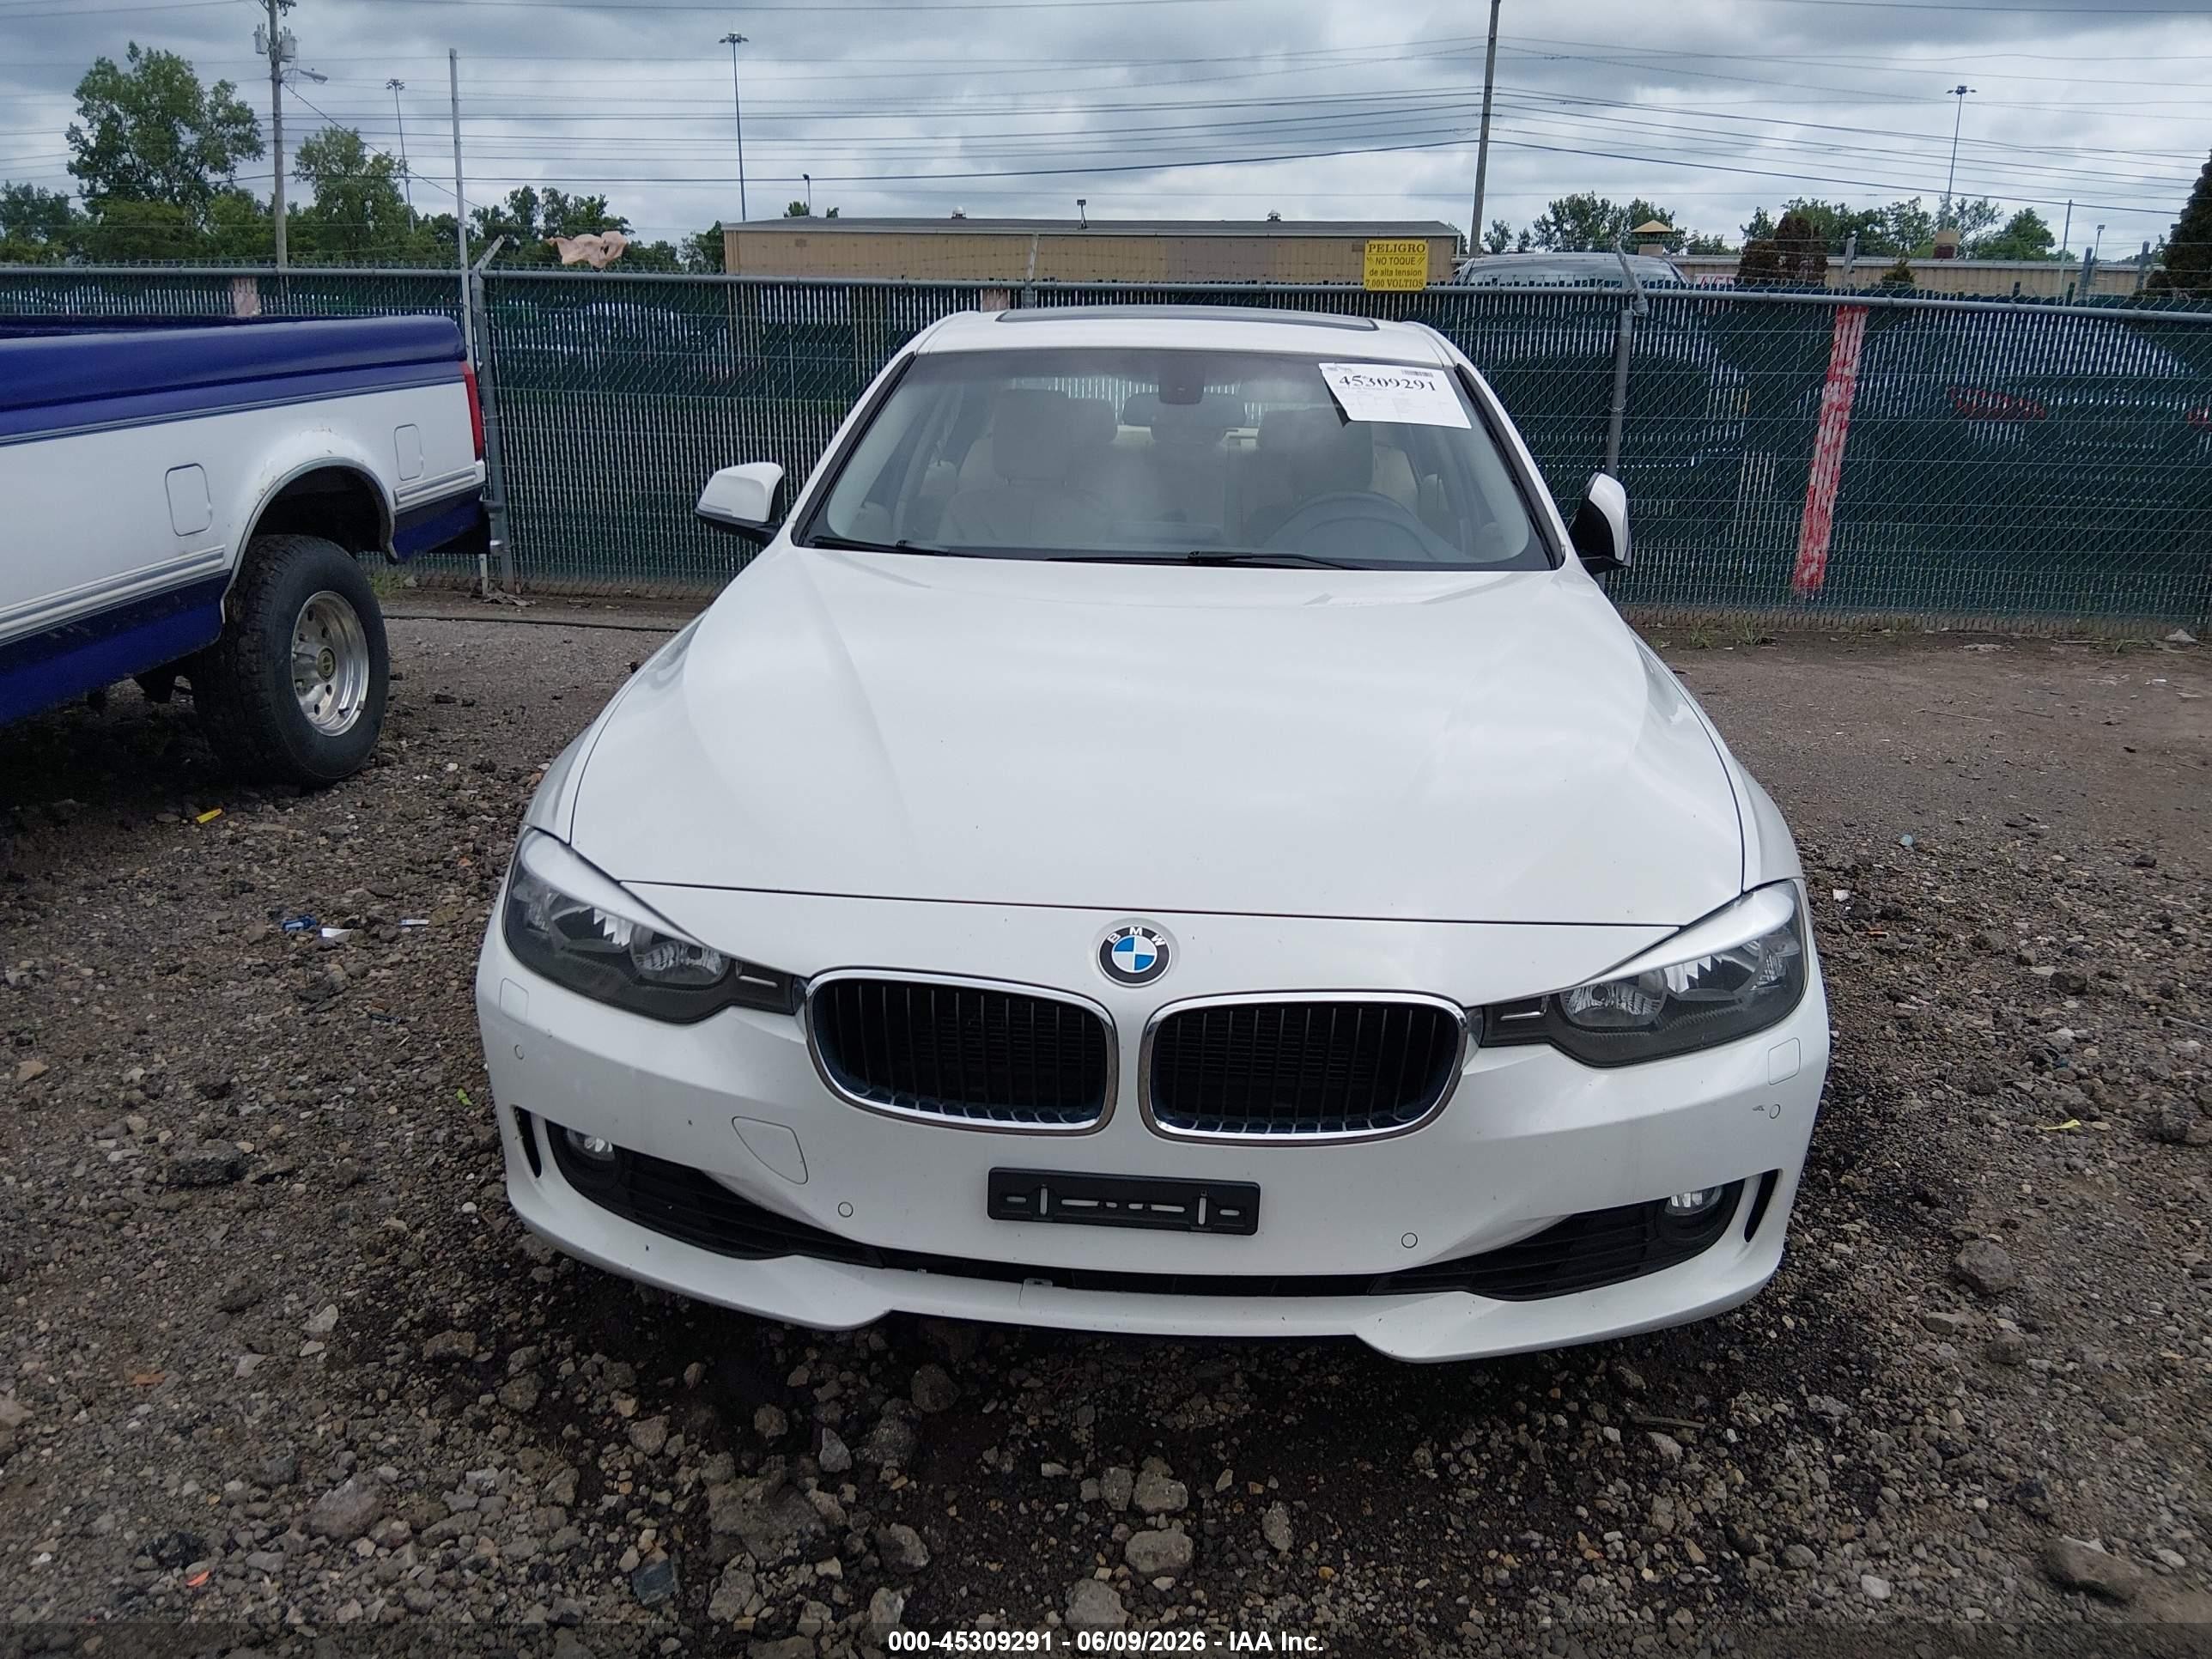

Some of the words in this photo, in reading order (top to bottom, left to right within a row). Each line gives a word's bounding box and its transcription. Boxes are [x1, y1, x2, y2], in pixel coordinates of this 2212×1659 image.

[1369, 244, 1425, 253] PELIGRO
[1376, 257, 1387, 265] NO
[1389, 257, 1416, 265] TOQUE
[1369, 268, 1378, 276] de
[1386, 278, 1424, 289] VOLTIOS
[1340, 374, 1436, 392] 45309291
[1107, 927, 1166, 946] BMW
